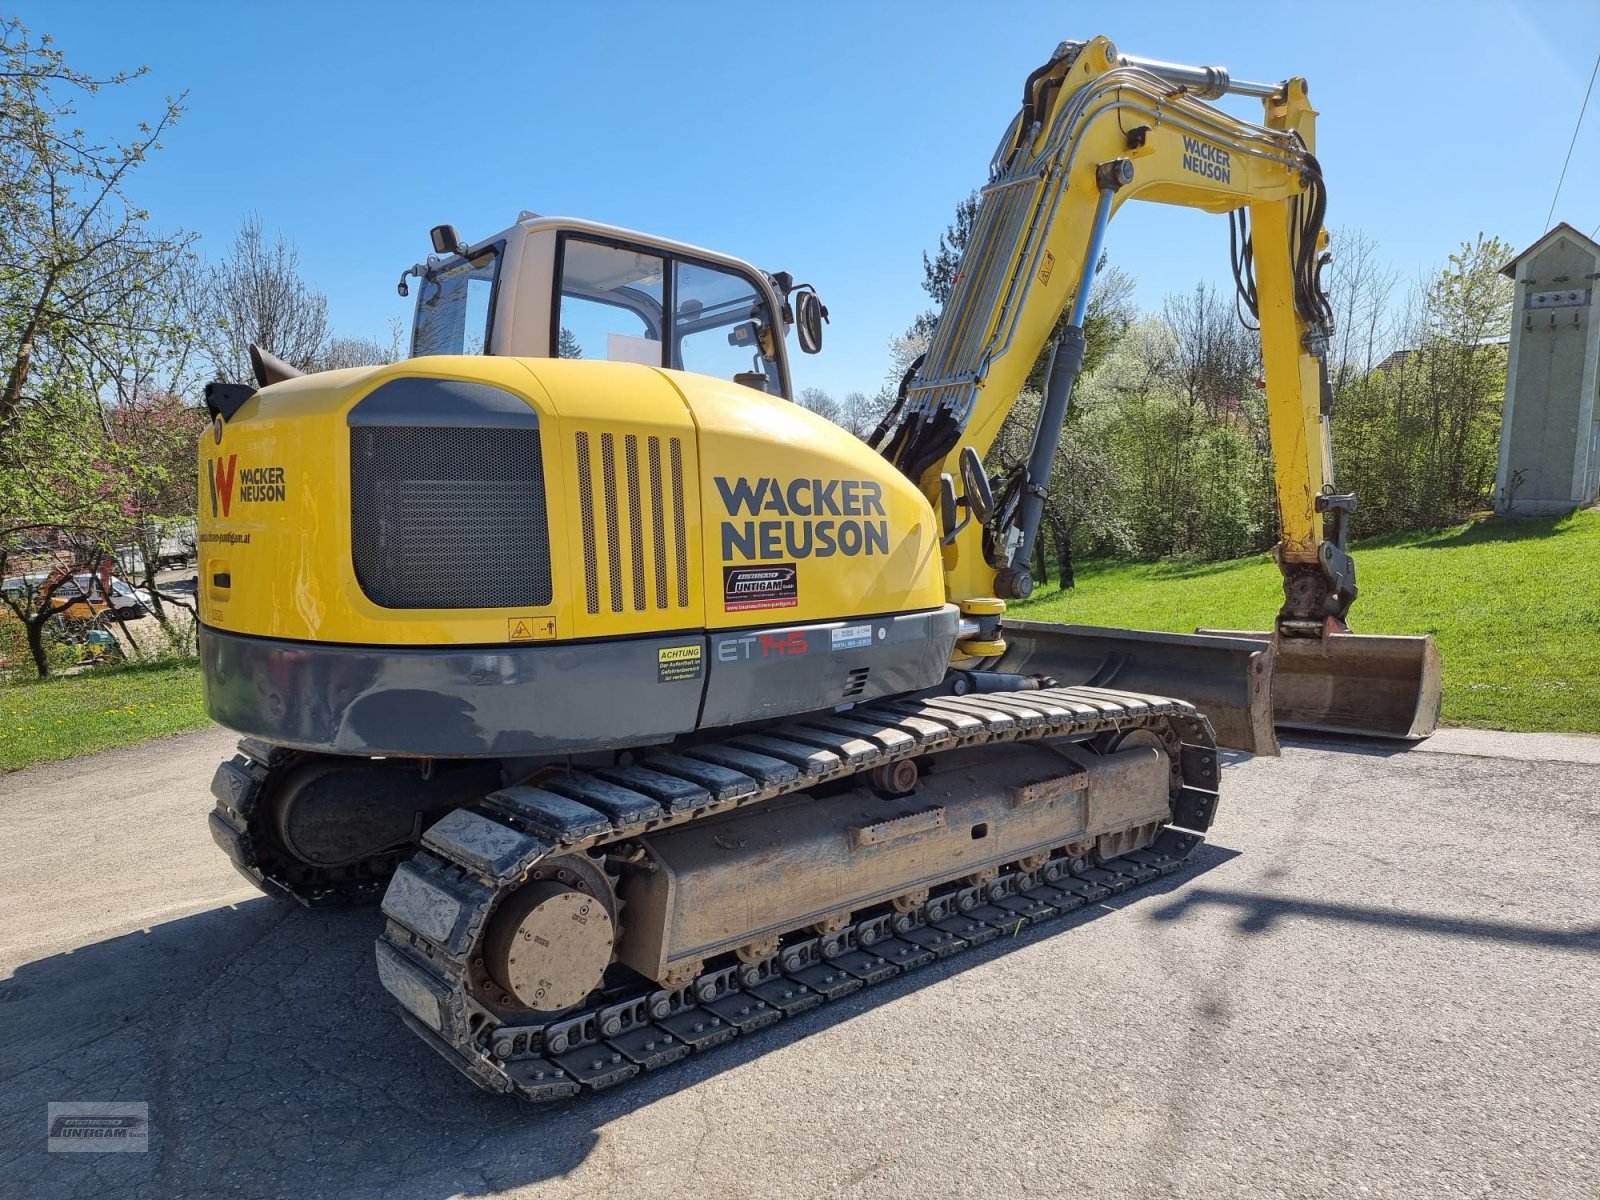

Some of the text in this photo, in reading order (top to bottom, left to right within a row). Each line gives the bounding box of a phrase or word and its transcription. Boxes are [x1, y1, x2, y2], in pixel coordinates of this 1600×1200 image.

[1182, 135, 1231, 168] WACKER
[1183, 153, 1231, 185] NEUSON
[239, 467, 286, 485] WACKER
[240, 484, 286, 503] NEUSON
[713, 476, 887, 517] WACKER
[721, 519, 890, 561] NEUSON
[661, 648, 699, 660] ACHTUNG
